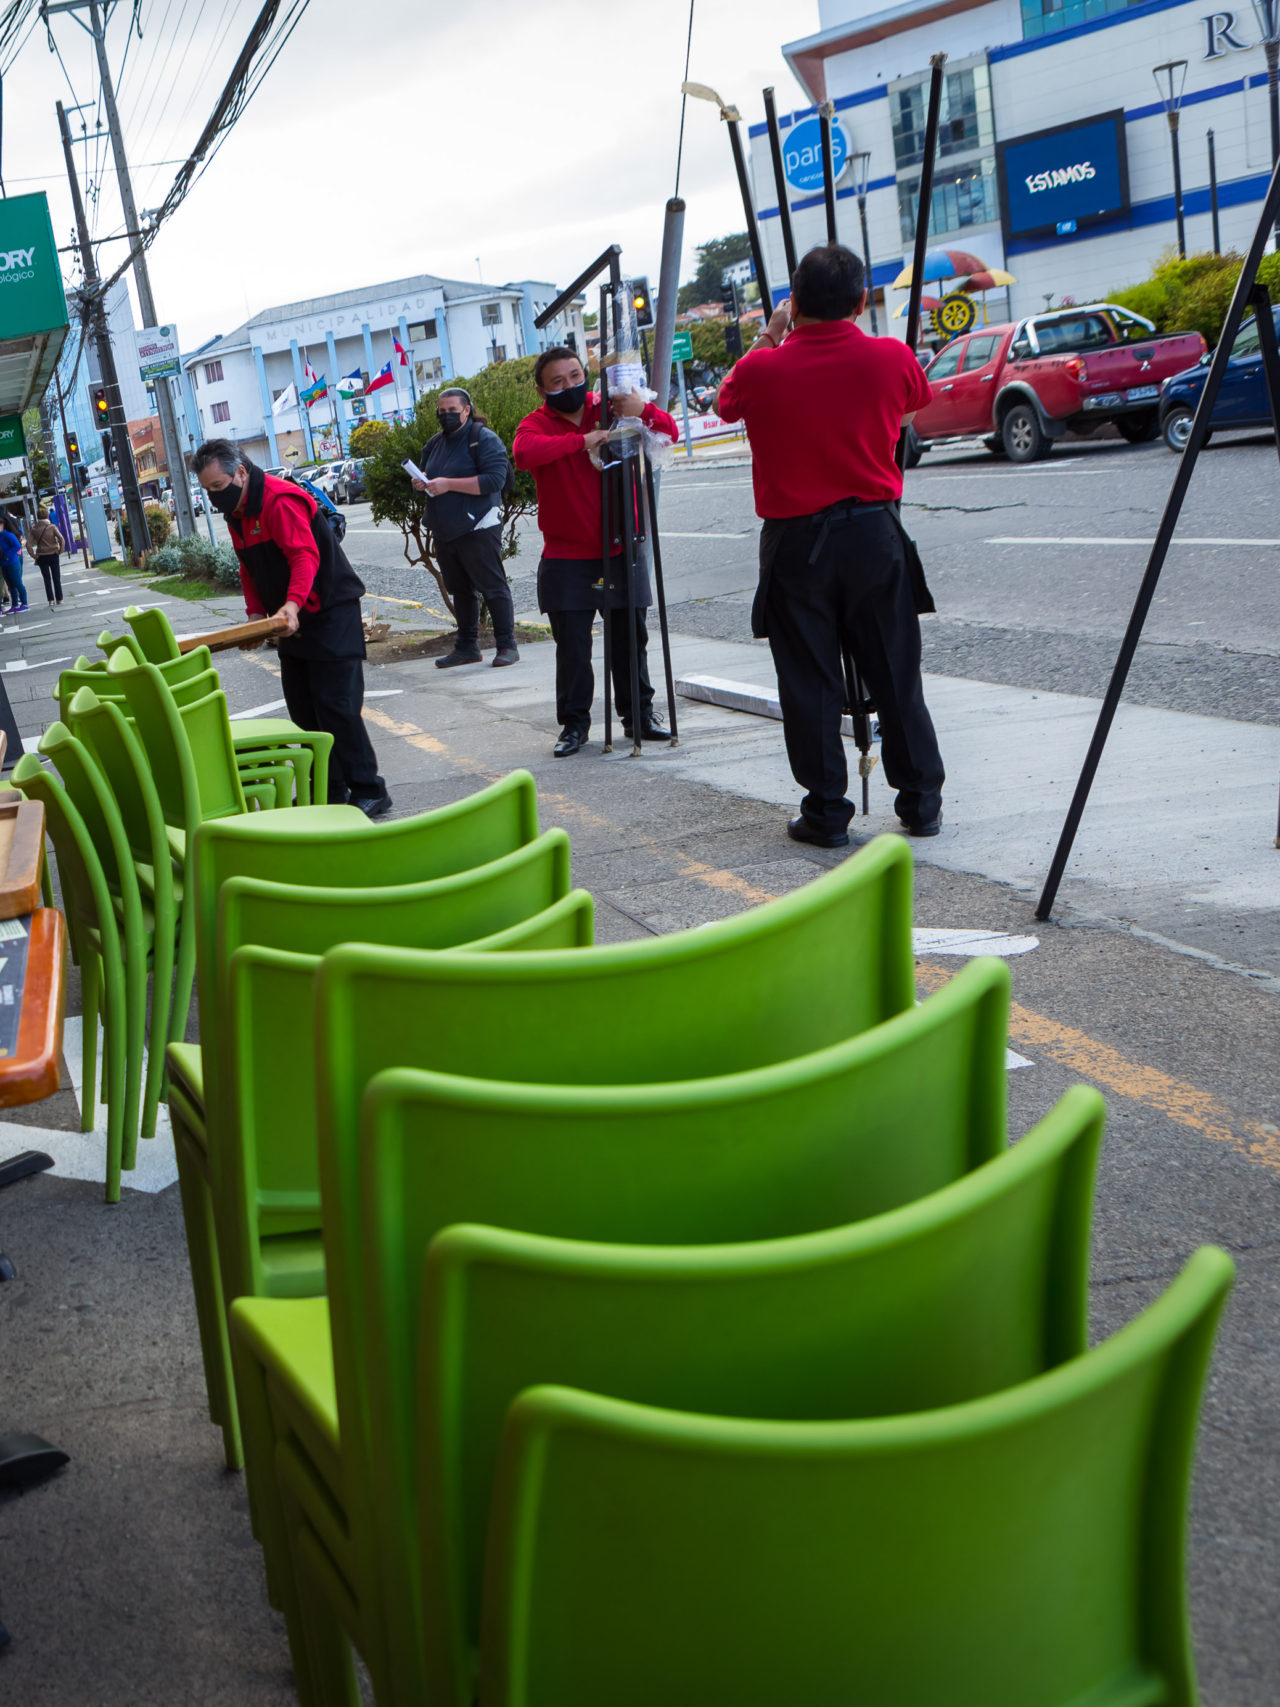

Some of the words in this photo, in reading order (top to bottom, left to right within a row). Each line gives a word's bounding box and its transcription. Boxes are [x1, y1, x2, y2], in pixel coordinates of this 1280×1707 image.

[786, 138, 842, 176] pars
[1025, 161, 1096, 194] ESTAMOS
[266, 298, 425, 341] MUNICIPALIDAD
